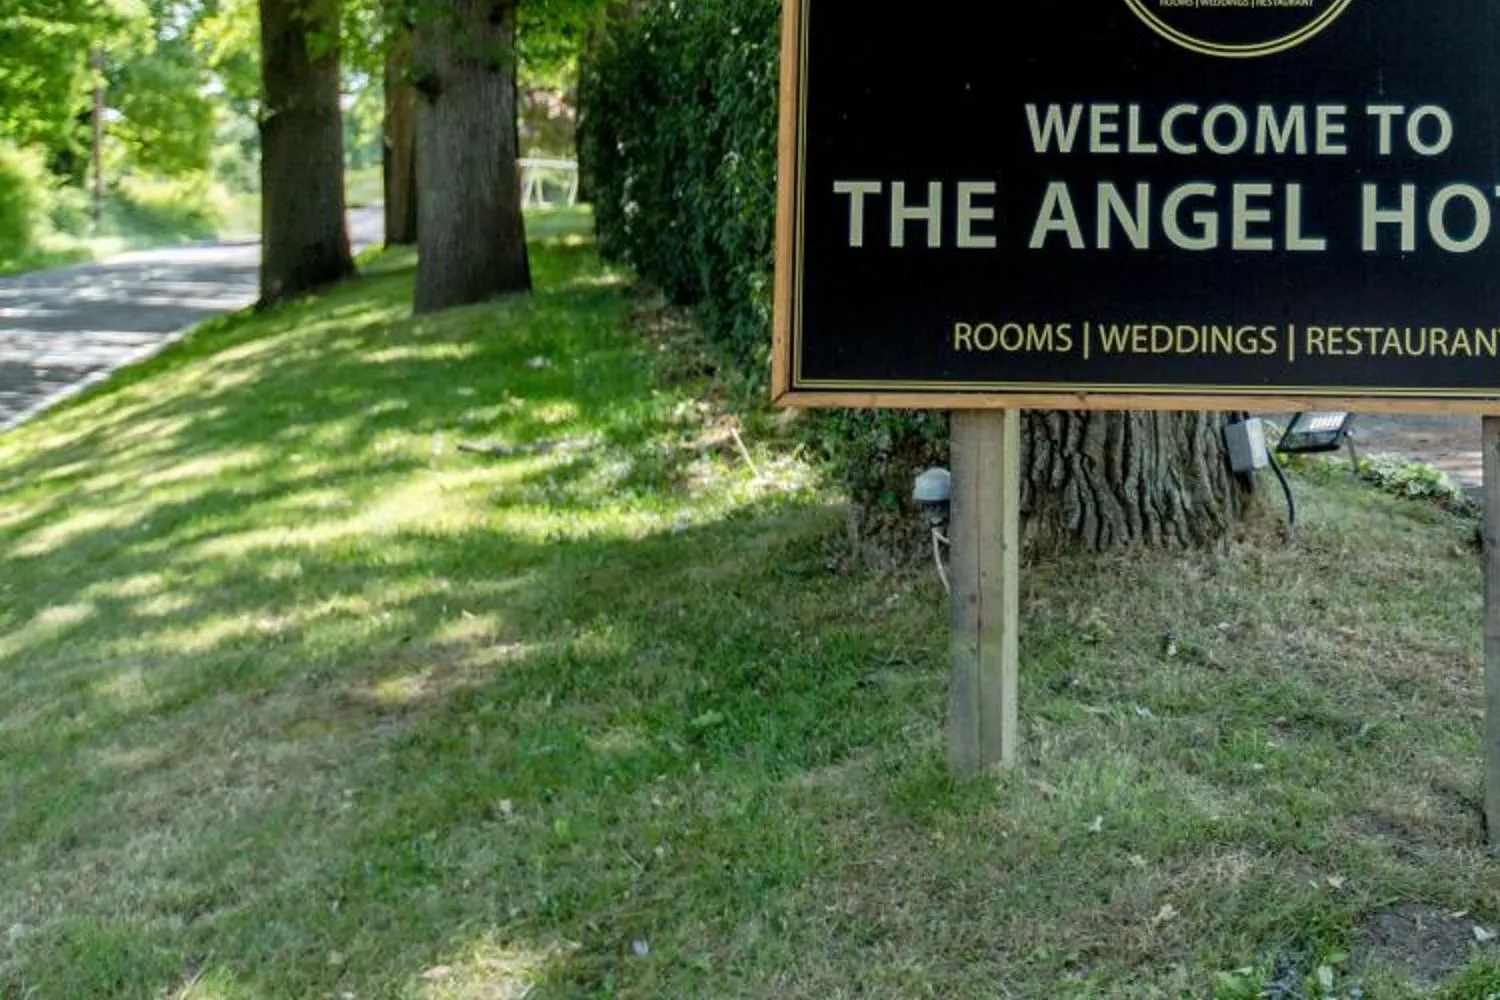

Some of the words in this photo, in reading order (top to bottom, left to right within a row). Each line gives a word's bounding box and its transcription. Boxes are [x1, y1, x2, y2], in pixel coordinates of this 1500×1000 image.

[1025, 103, 1348, 155] WELCOME
[1365, 104, 1453, 156] TO
[833, 180, 998, 249] THE
[1028, 181, 1327, 251] ANGEL
[953, 322, 1073, 352] ROOMS
[1098, 324, 1278, 355] WEDDINGS
